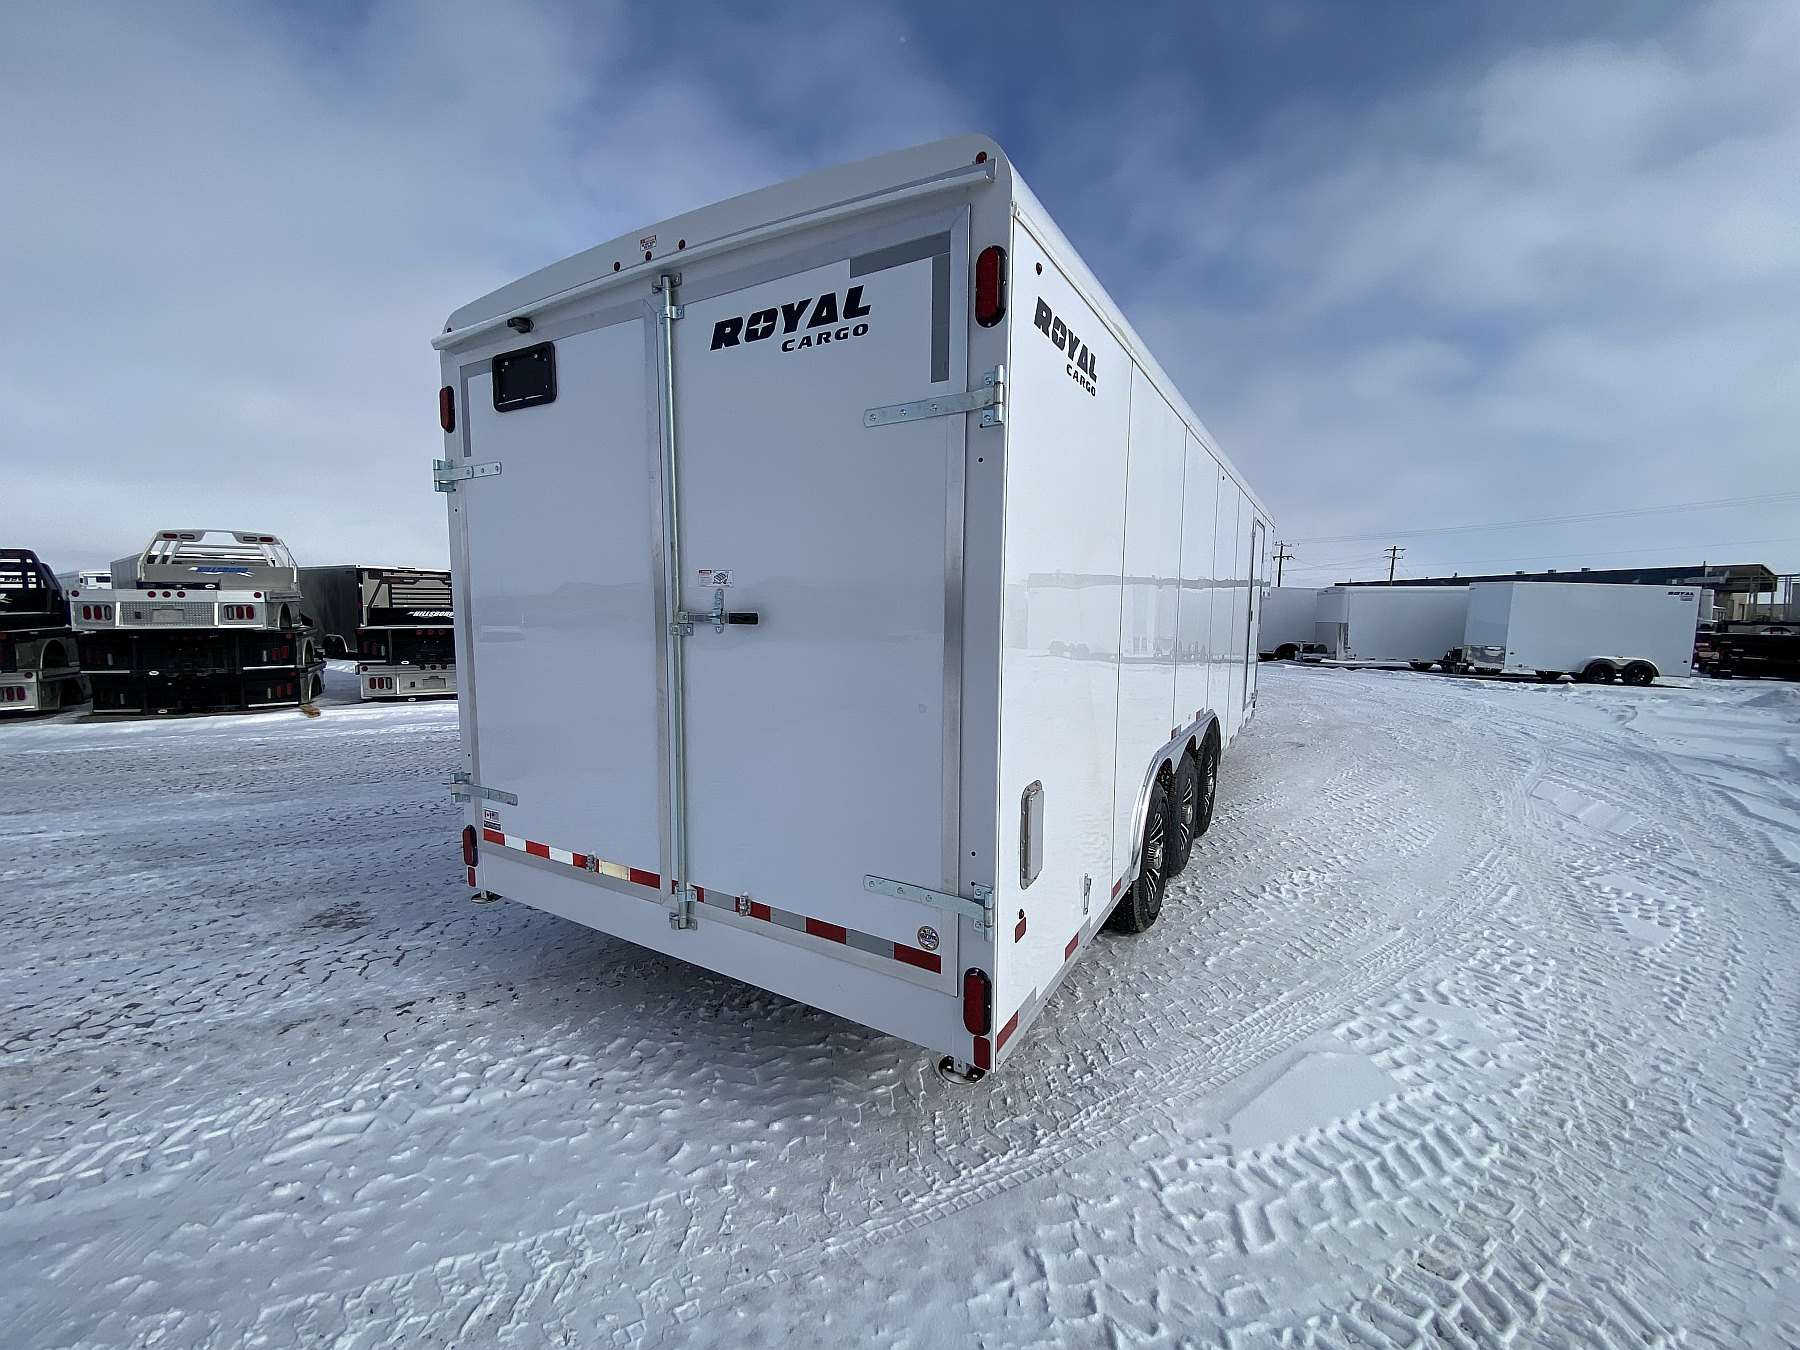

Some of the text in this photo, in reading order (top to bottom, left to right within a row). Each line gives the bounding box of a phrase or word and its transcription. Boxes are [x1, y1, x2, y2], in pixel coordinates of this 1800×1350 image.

[710, 285, 872, 351] ROYAL
[781, 323, 869, 352] CARGO
[1034, 296, 1097, 383] ROYAL
[1066, 364, 1096, 397] CARGO
